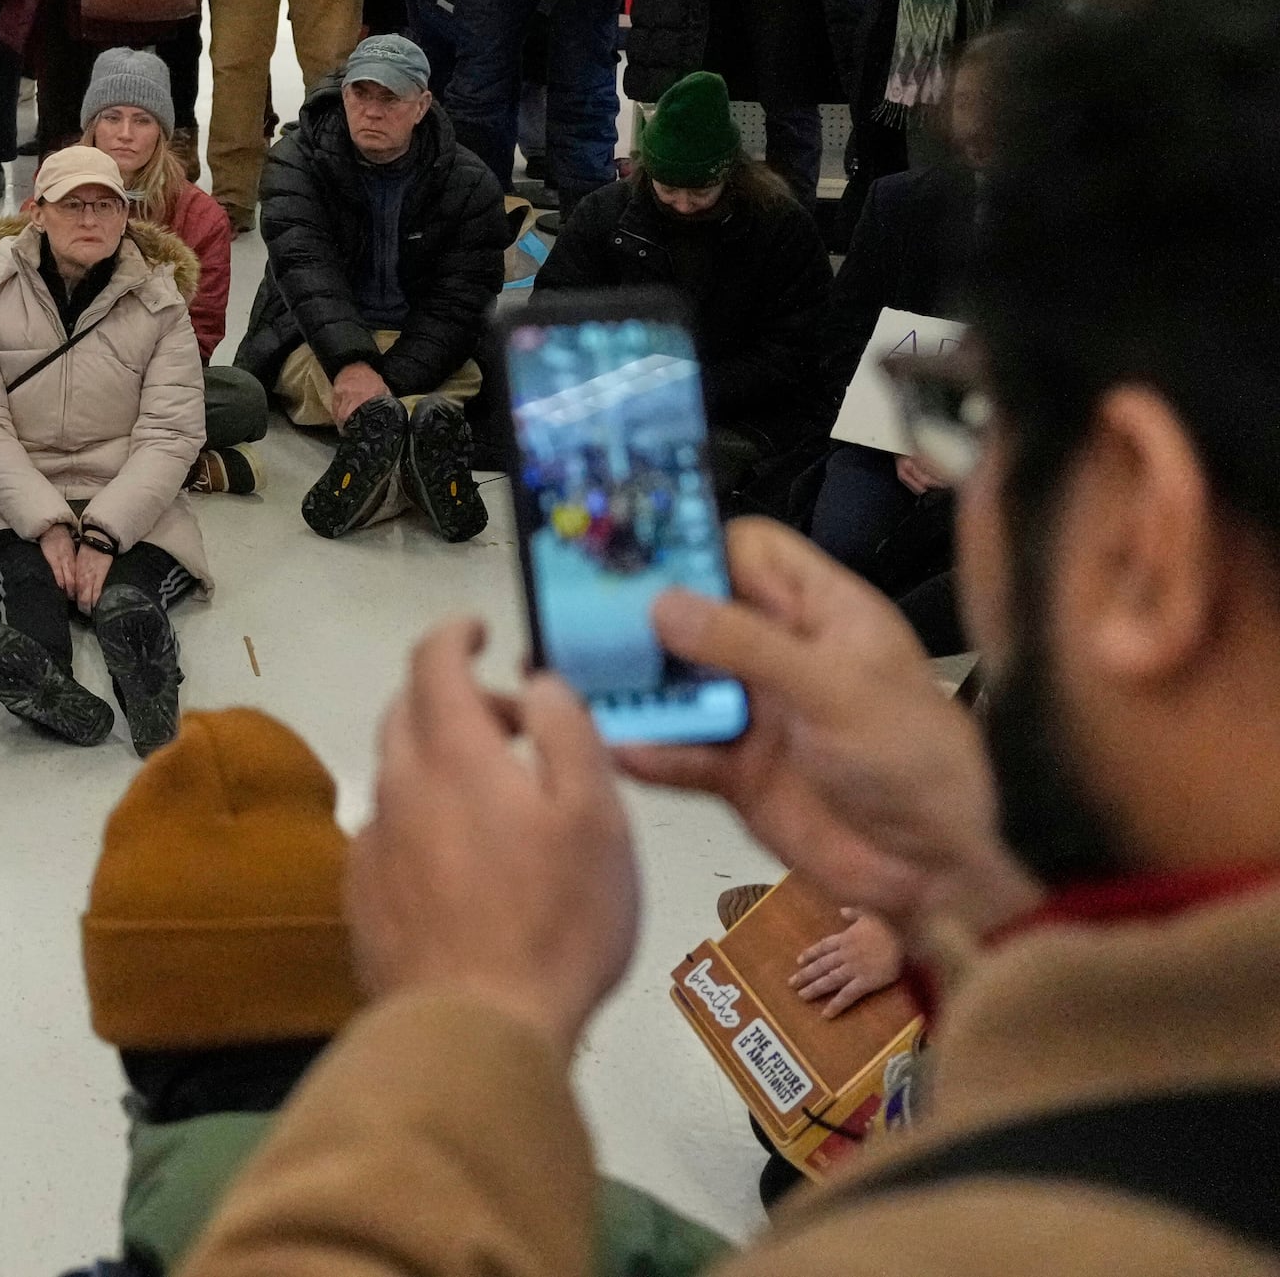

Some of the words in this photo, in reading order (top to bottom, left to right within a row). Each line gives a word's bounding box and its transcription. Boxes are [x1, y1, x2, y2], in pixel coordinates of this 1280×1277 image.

[688, 962, 737, 1024] breathe
[738, 1035, 751, 1049] IS
[746, 1046, 795, 1104] ABOLITIONIST
[750, 1026, 773, 1052] THE
[768, 1050, 807, 1096] FUTURE
